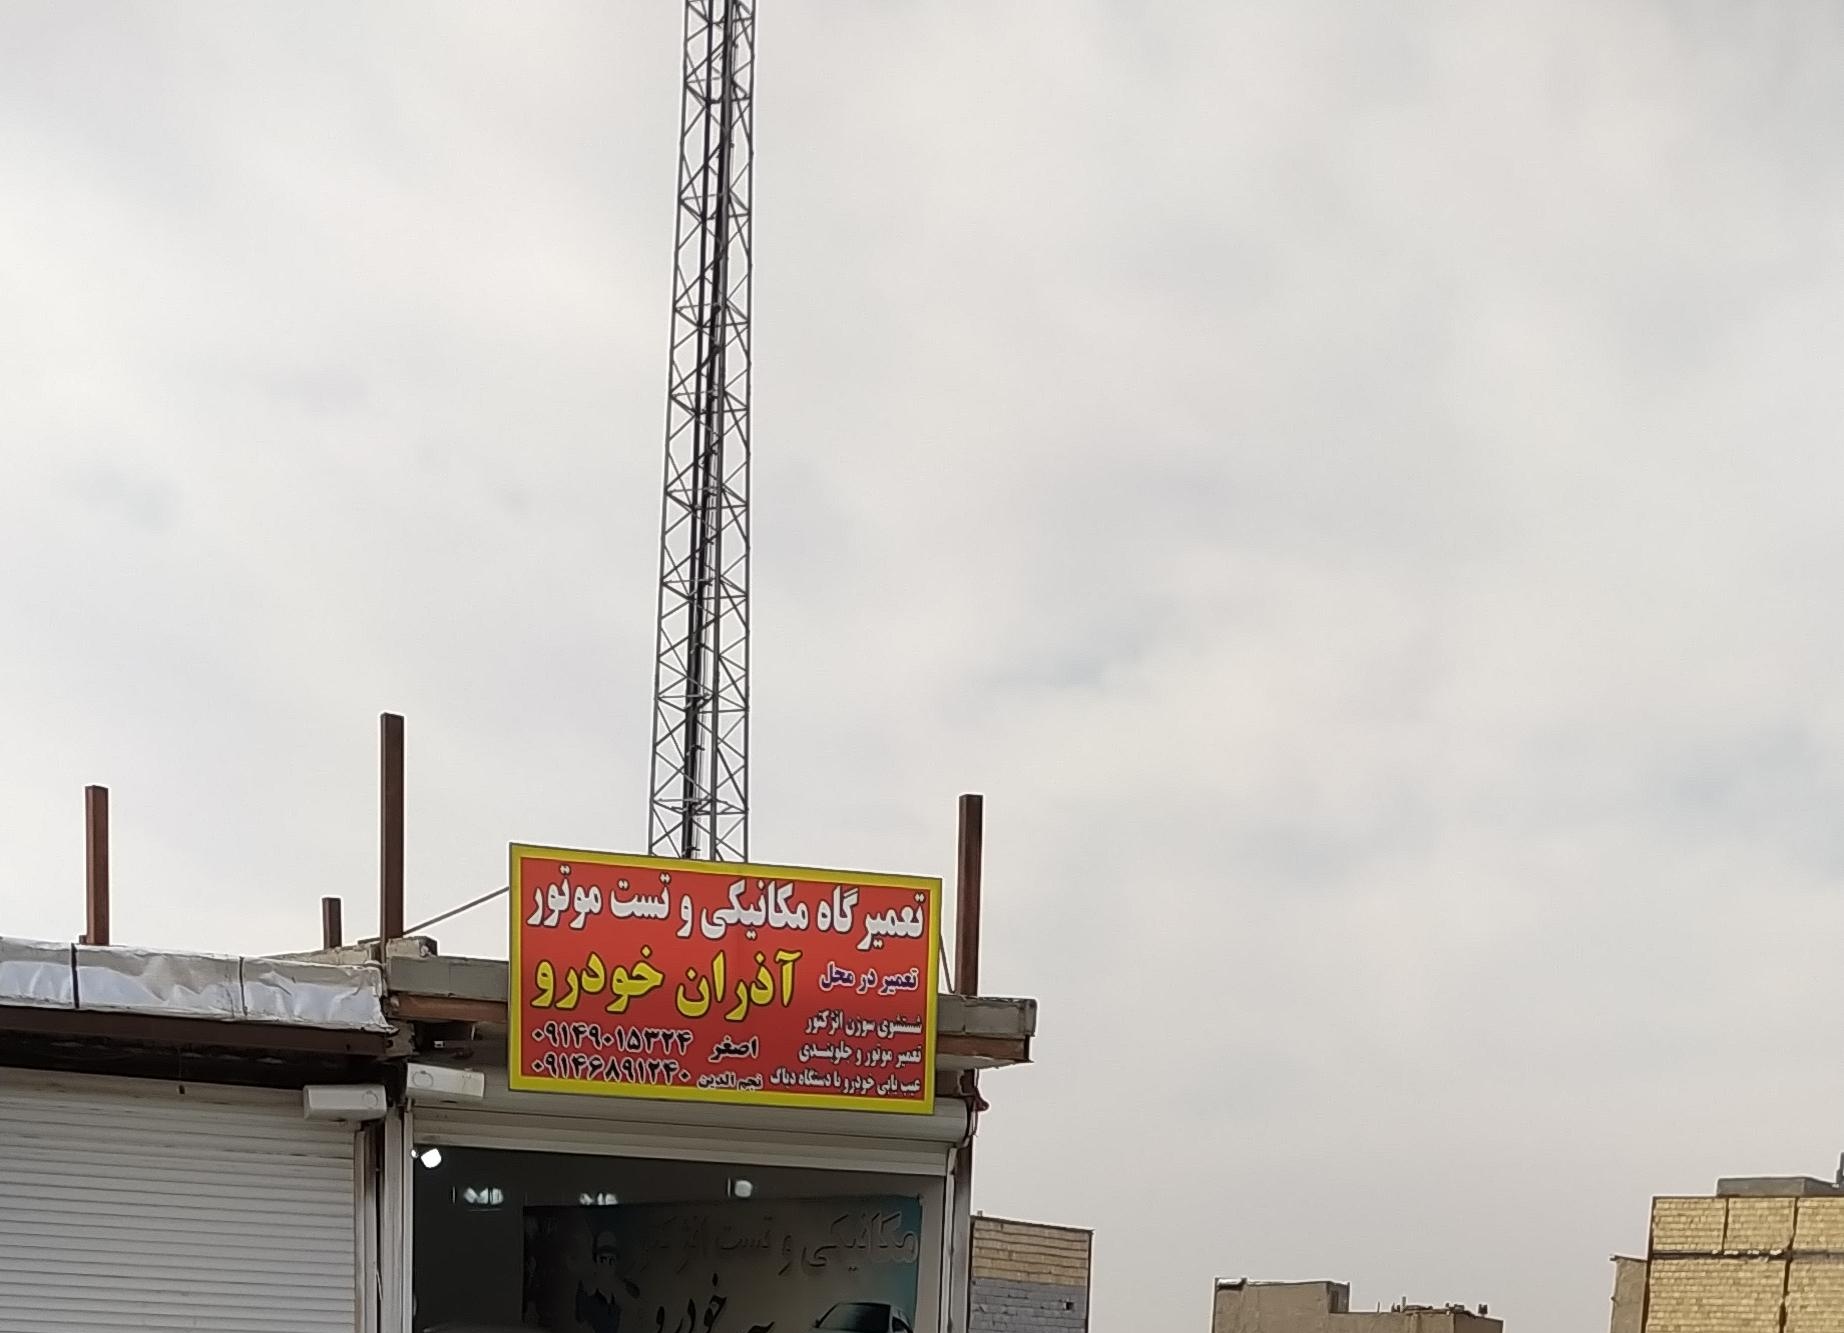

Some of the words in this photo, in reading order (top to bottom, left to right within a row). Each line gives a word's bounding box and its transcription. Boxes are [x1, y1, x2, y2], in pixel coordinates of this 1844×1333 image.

[526, 864, 603, 930] موتور
[610, 872, 672, 921] تست
[700, 876, 810, 940] مکانیکی
[815, 883, 860, 933] گاه
[676, 893, 693, 939] و
[856, 891, 927, 951] تعمیر
[530, 944, 665, 1013] خودرو
[674, 948, 804, 1021] آذران
[819, 961, 856, 992] محل
[855, 968, 877, 994] در
[877, 967, 919, 995] تعمیر
[805, 1009, 844, 1035] انژکتور
[845, 1015, 875, 1037] سوزن
[876, 1013, 922, 1038] شستشوی
[532, 1020, 694, 1055] ۰۹۱۴۹۰۱۵۳۲۴
[708, 1035, 759, 1063] اصغر
[532, 1050, 692, 1086] ۰۹۱۴۶۸۹۱۲۴۰
[855, 1048, 863, 1066] و
[864, 1043, 893, 1067] موتور
[895, 1044, 922, 1068] تعمیر
[697, 1071, 736, 1090] الدین
[737, 1072, 764, 1092] نجم
[799, 1068, 832, 1087] دستگاه
[833, 1070, 842, 1089] با
[842, 1073, 875, 1094] خودرو
[877, 1073, 898, 1096] یابی
[900, 1078, 921, 1096] عیب
[778, 1235, 793, 1276] و
[802, 1211, 918, 1272] مکانیکی
